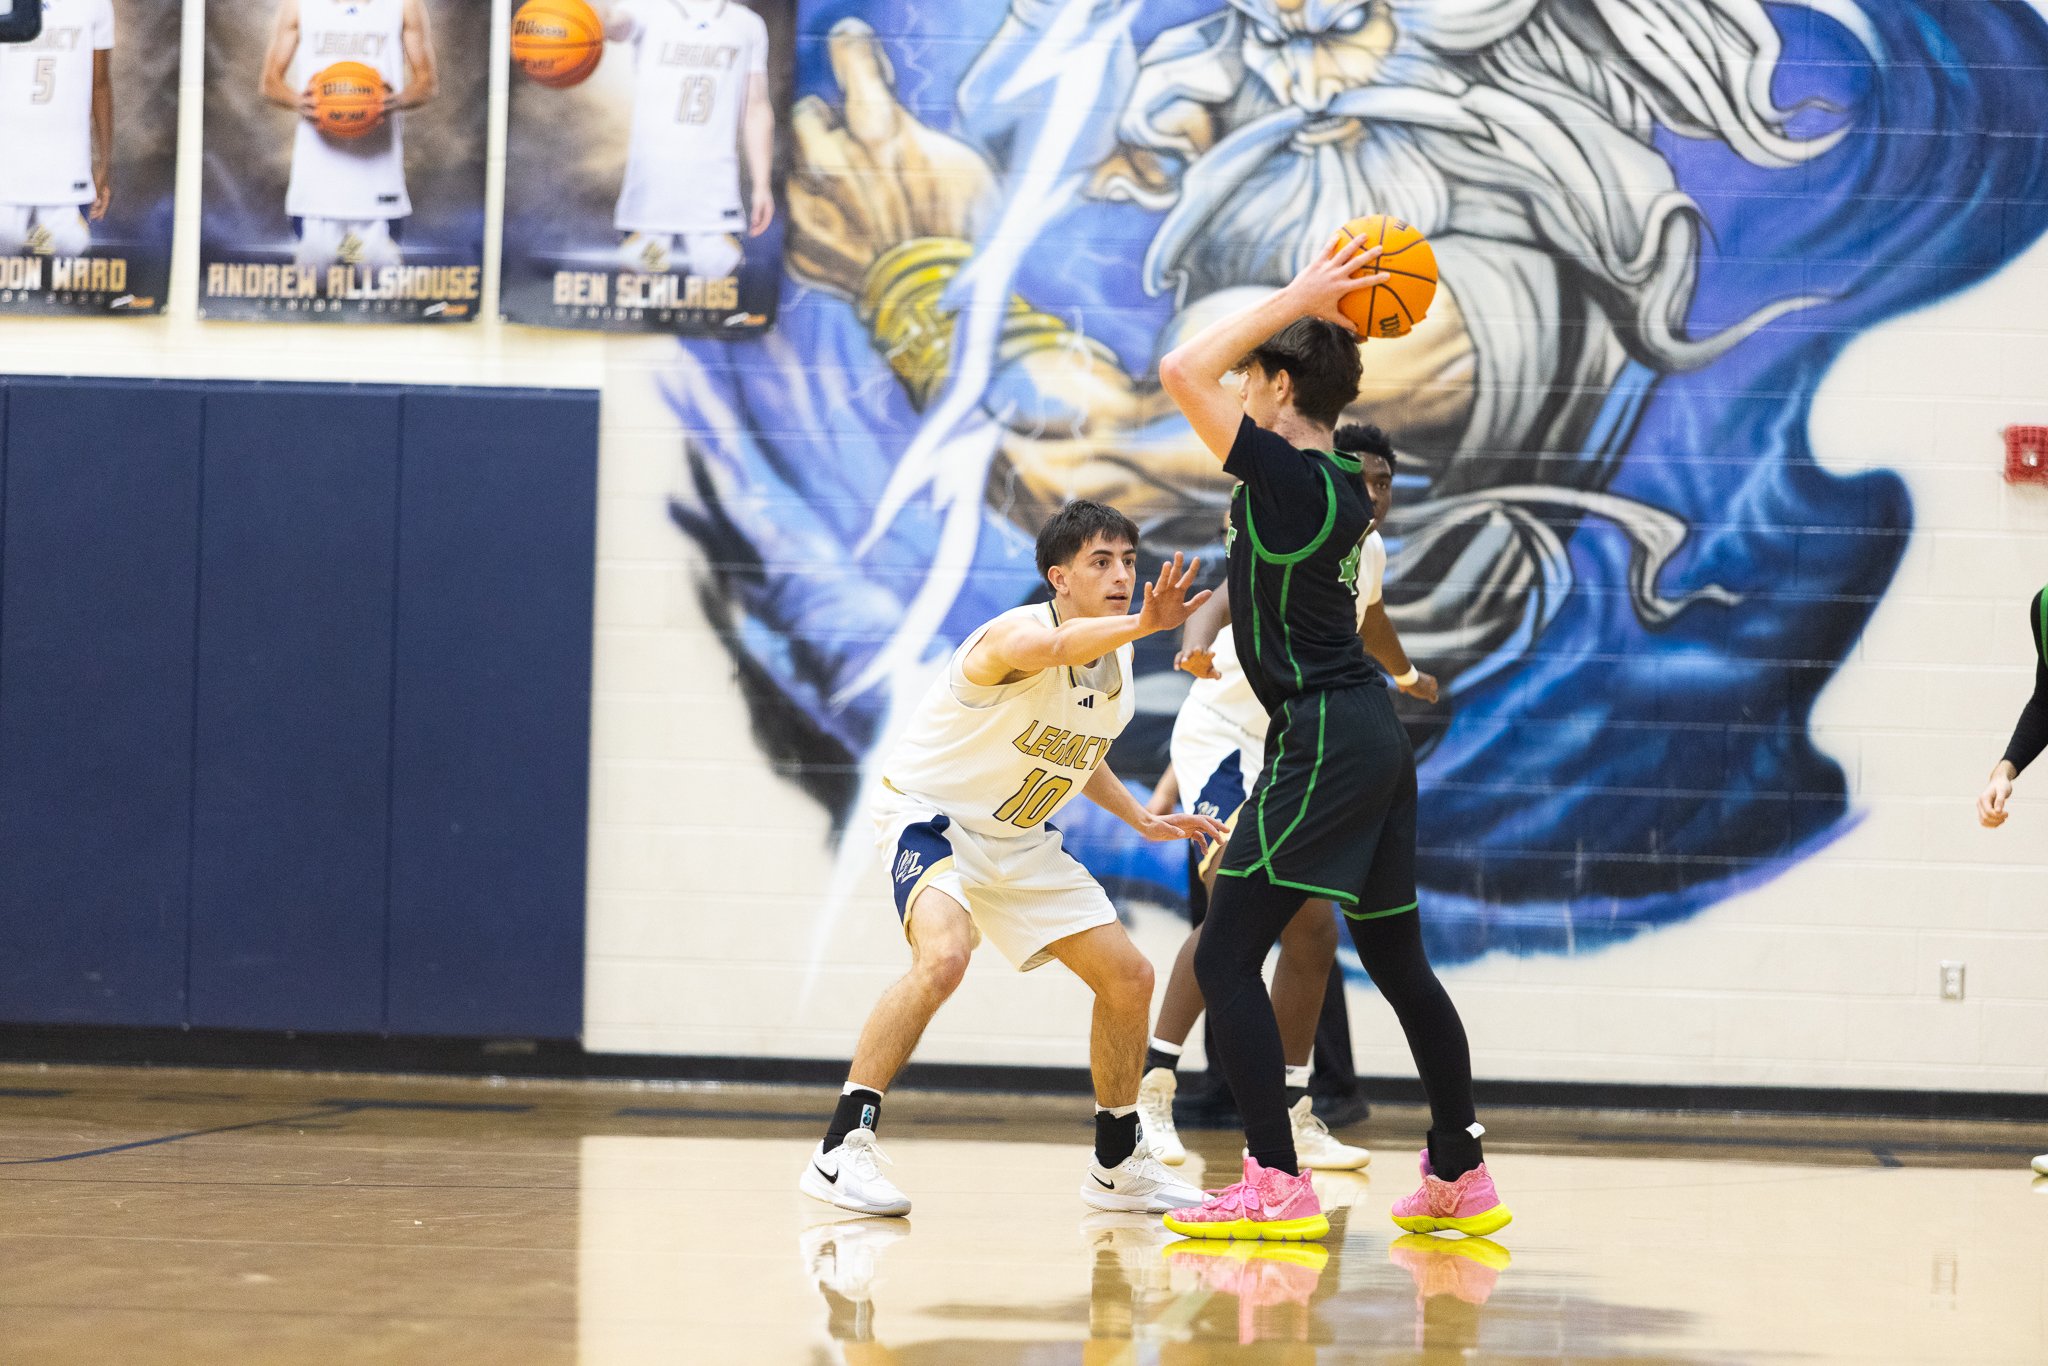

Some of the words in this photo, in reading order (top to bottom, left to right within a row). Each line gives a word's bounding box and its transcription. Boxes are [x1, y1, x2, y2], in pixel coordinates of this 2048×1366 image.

[30, 56, 57, 105] 5
[674, 74, 717, 125] 13
[51, 256, 127, 292] WARD
[207, 261, 318, 299] ANDREW
[326, 263, 480, 302] ALLSHOUSE
[553, 270, 609, 306] BEN
[615, 273, 739, 310] SCHLABS
[1011, 719, 1115, 771] LEGACY
[991, 767, 1073, 829] 10
